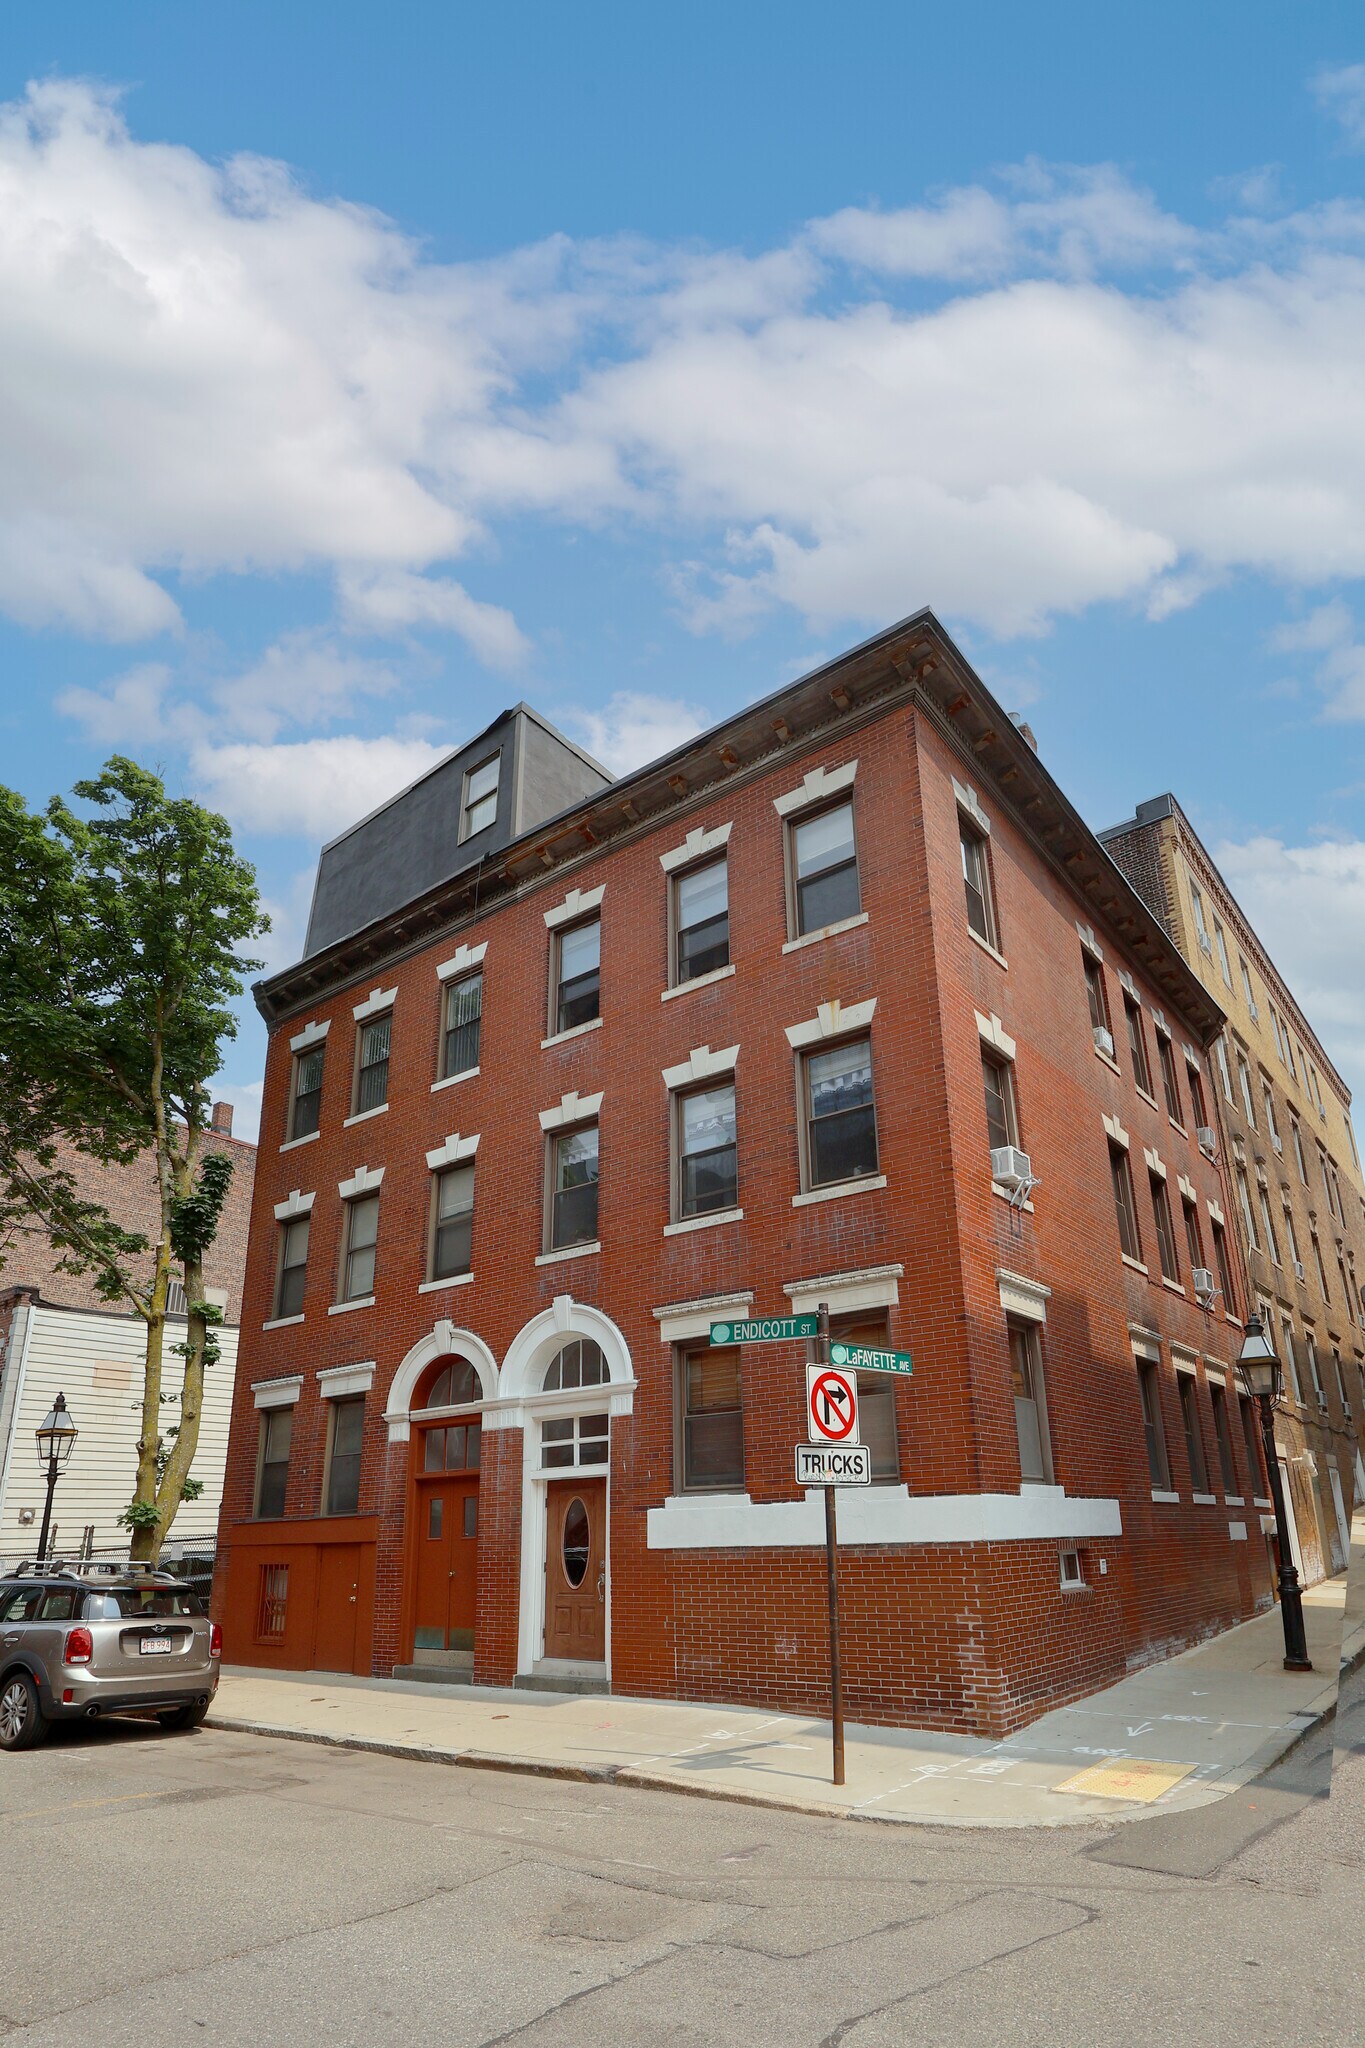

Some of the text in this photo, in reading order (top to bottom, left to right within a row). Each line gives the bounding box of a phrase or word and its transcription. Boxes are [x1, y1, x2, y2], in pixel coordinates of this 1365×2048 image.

[734, 1320, 811, 1340] ENDICOTT ST
[846, 1348, 910, 1371] LaFAYETTE AVE
[802, 1454, 863, 1475] TRUCKS
